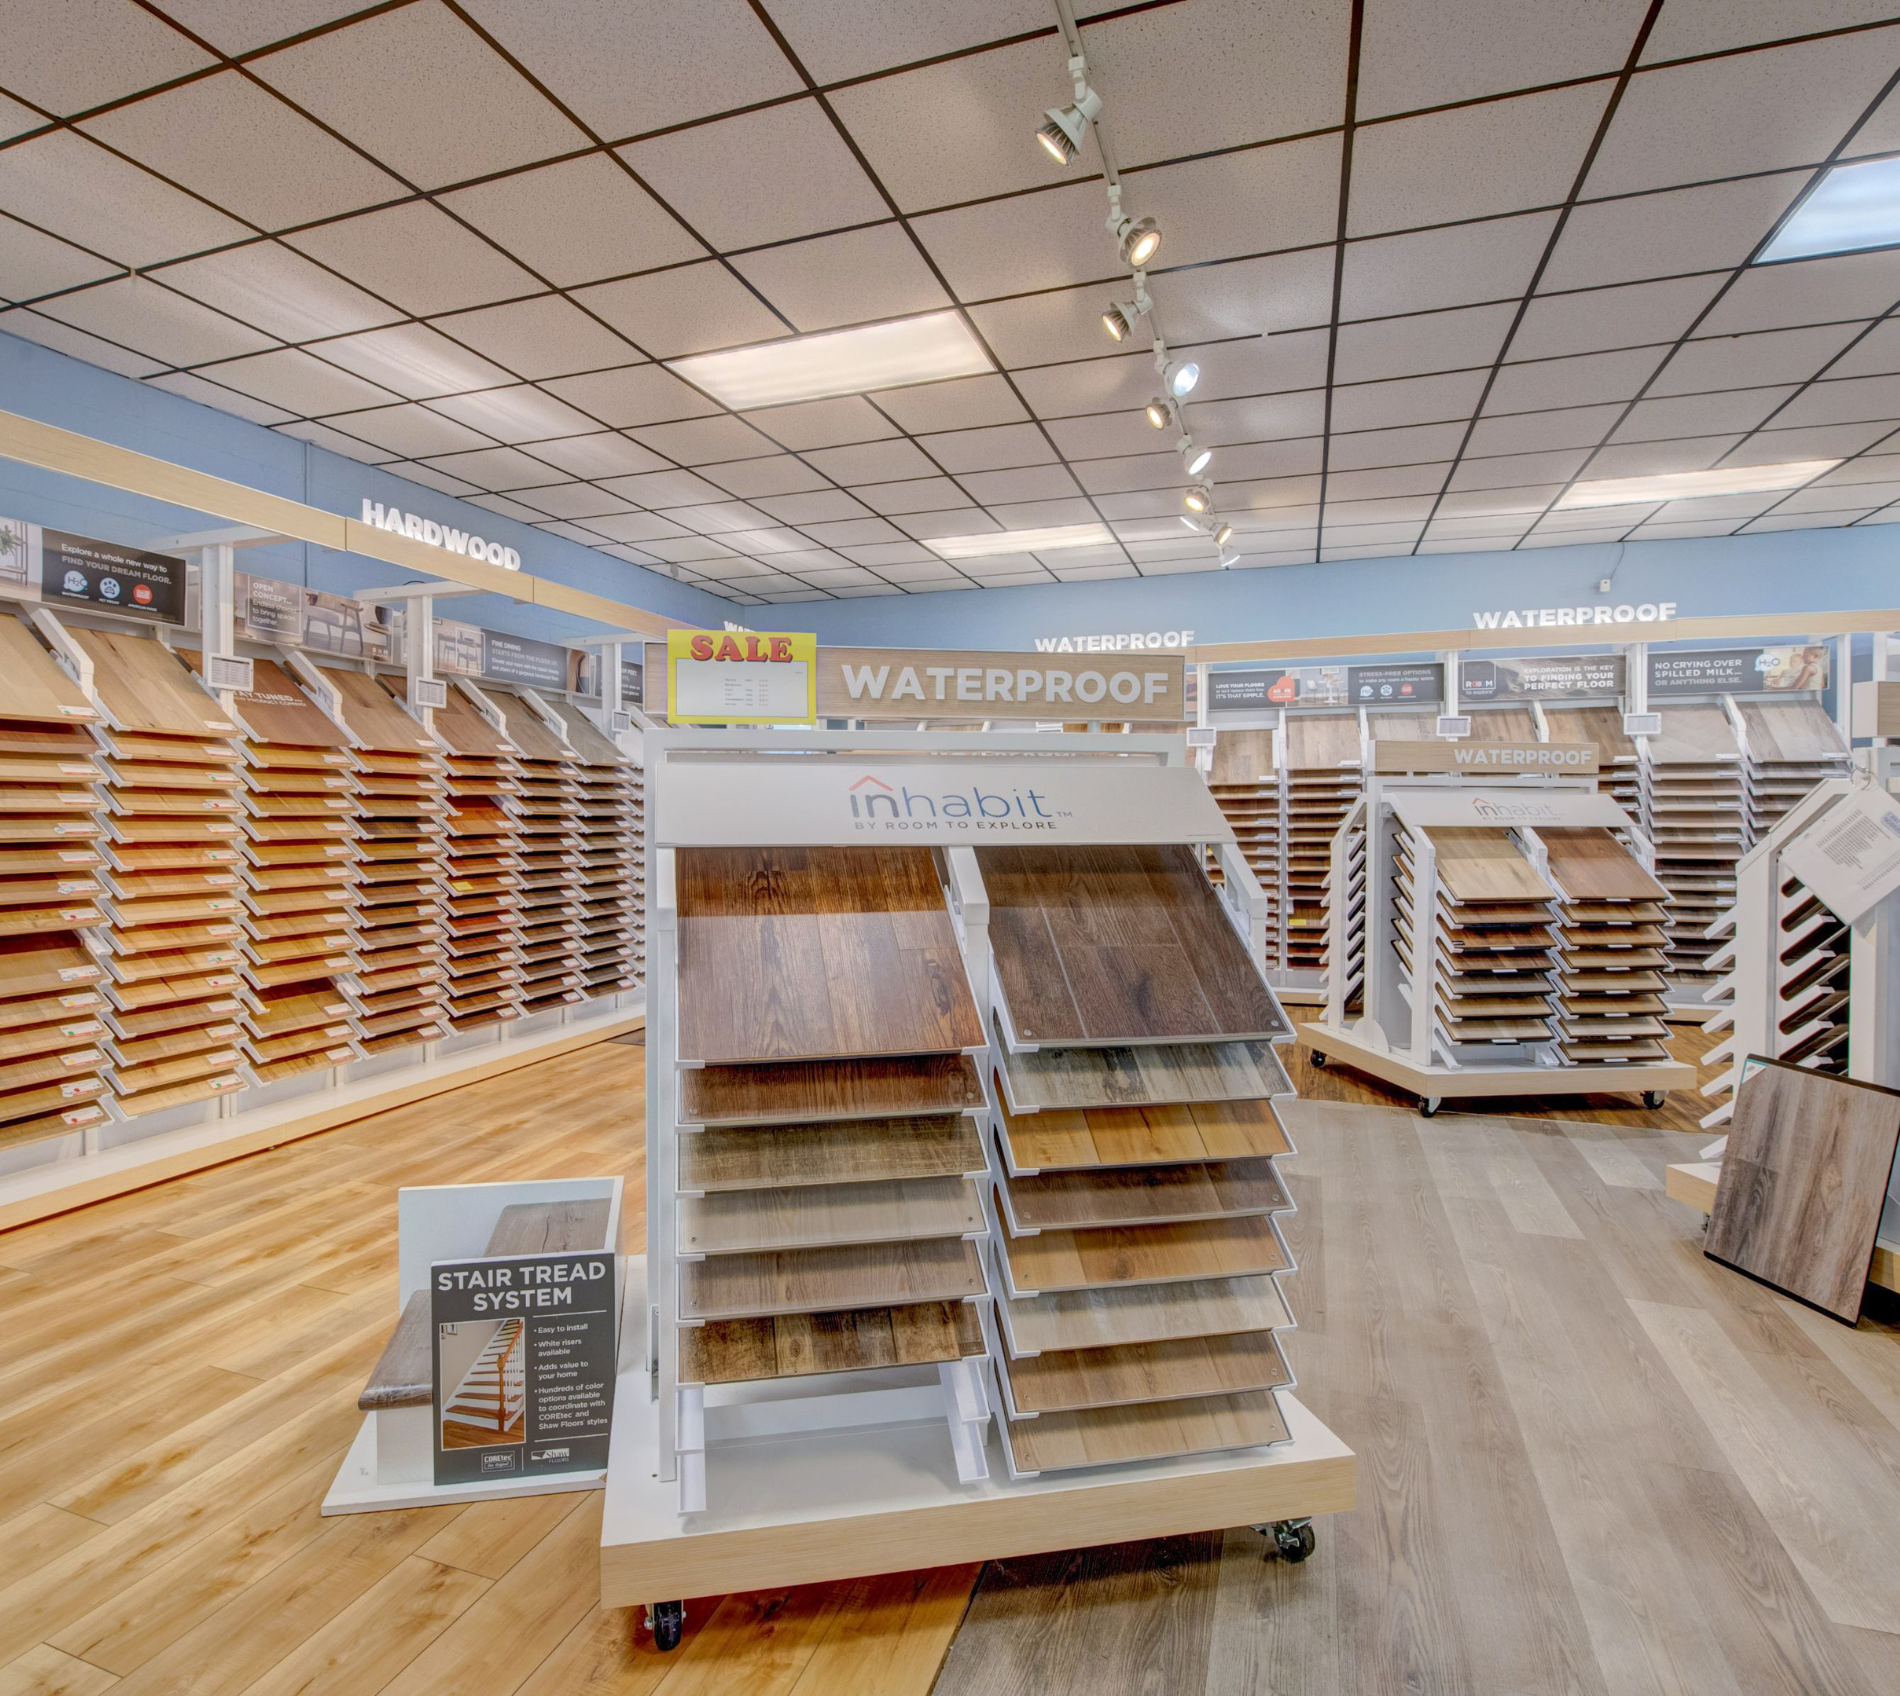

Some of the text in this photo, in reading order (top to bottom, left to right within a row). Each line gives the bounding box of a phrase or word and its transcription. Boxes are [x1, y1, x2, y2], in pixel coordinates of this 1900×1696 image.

[362, 498, 521, 572] HARDWOOD
[62, 544, 92, 557] Explore
[101, 554, 124, 564] whole
[126, 558, 141, 567] new
[143, 562, 158, 572] way
[62, 555, 172, 584] FIND YOUR DREAM FLOOR.
[253, 582, 274, 592] OPEN
[252, 599, 275, 610] Endless
[260, 608, 275, 618] bring
[1473, 602, 1677, 630] WATERPROOF
[492, 640, 503, 648] FINE
[1034, 630, 1195, 652] WATERPROOF
[690, 634, 793, 662] SALE
[1672, 660, 1711, 669] CRYING
[1713, 659, 1742, 667] OVER
[841, 663, 1169, 704] WATERPROOF
[1524, 680, 1614, 690] PERFECT FLOOR
[1454, 749, 1592, 765] WATERPROOF
[849, 786, 1053, 818] inhabit
[1474, 802, 1558, 816] inhabit
[855, 821, 1058, 830] BY ROOM TO EXPLORE
[438, 1262, 606, 1291] STAIR TREAD
[473, 1287, 572, 1311] SYSTEM
[567, 1323, 588, 1331] install
[538, 1348, 570, 1356] available
[539, 1385, 574, 1393] Hundreds
[568, 1392, 600, 1400] available
[548, 1402, 587, 1410] coordinate
[547, 1450, 568, 1458] Shaw
